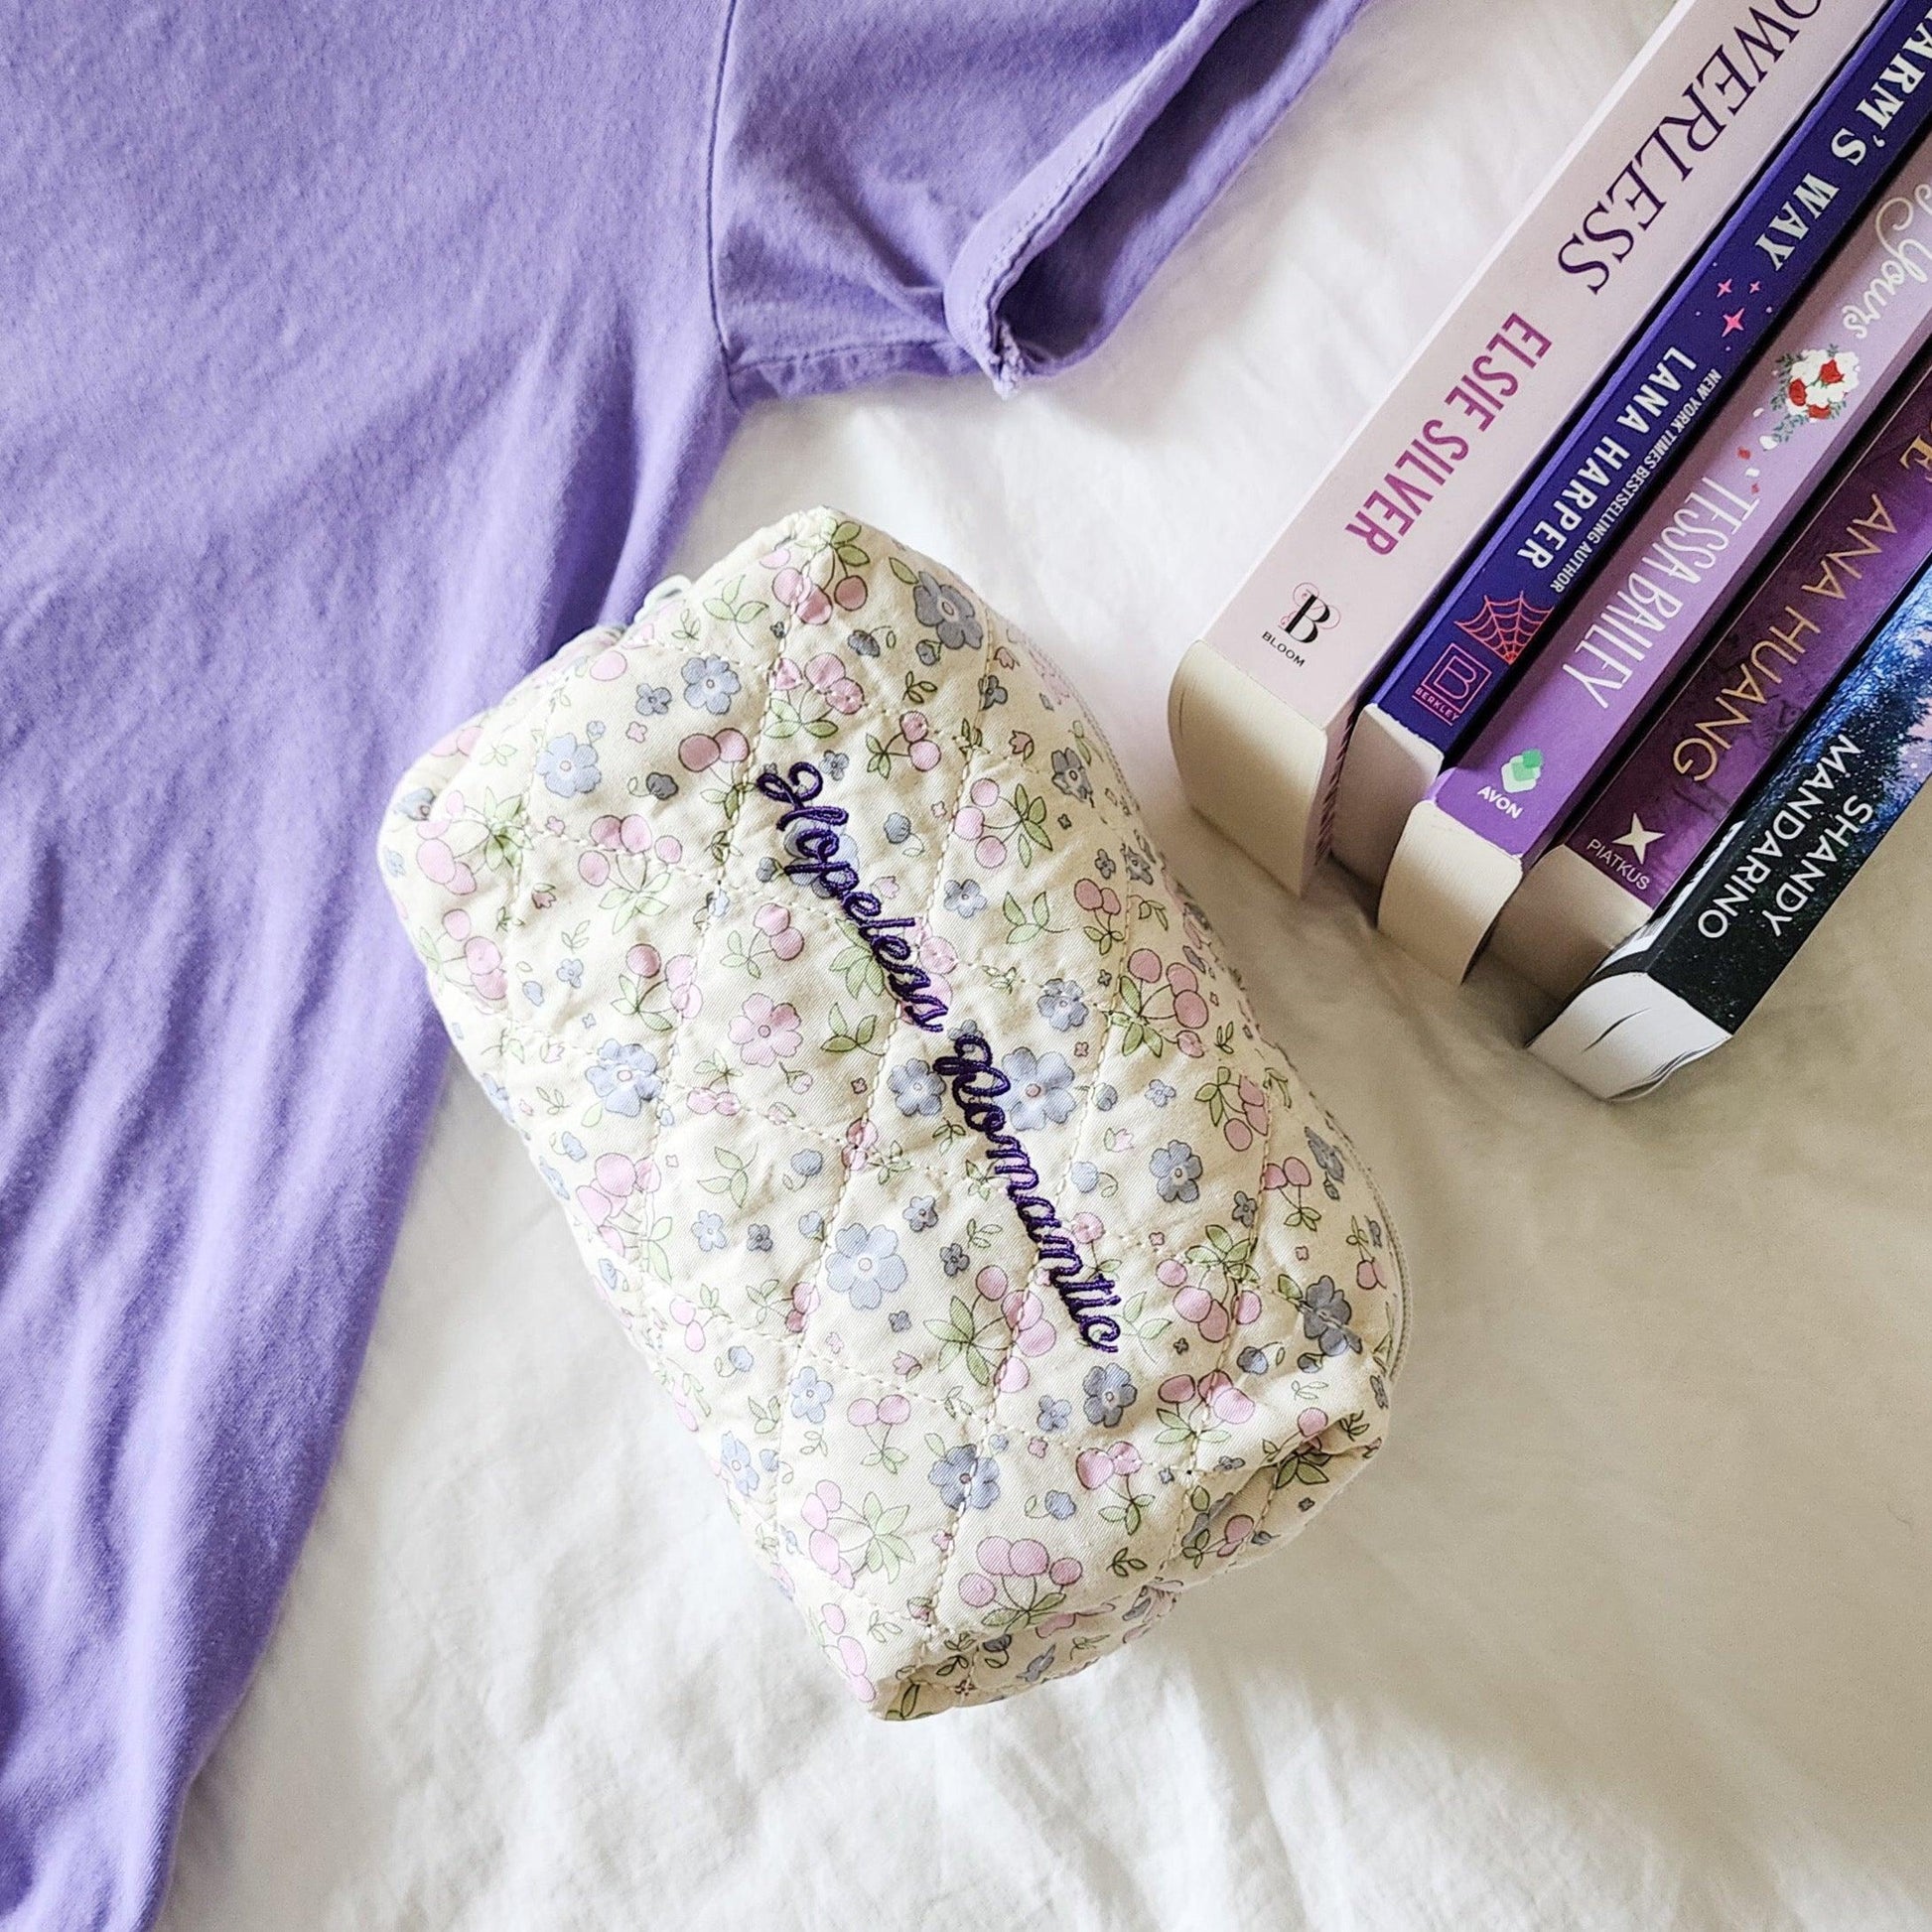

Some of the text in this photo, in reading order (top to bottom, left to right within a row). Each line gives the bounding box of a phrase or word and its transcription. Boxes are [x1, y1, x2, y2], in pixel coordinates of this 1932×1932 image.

[1754, 8, 1932, 271] ARM'S WAY
[1843, 197, 1932, 340] Yours
[1344, 312, 1553, 556] ELSIE SILVER
[1516, 346, 1698, 570] LANA HARPER
[1550, 368, 1723, 593] NEW YORK TIMES BESTSELLING AUTHOR
[1261, 630, 1306, 667] BLOOM
[1563, 476, 1760, 709] TESSA BAILEY
[1672, 493, 1898, 782] ANA HUANG
[1415, 687, 1459, 721] BERKLEY
[1476, 784, 1524, 819] AVON
[1586, 838, 1650, 892] PIATKUS
[1697, 734, 1862, 940] MANDARINO
[1762, 799, 1873, 938] SHANDY
[756, 760, 1120, 1354] Hopeless Romantic
